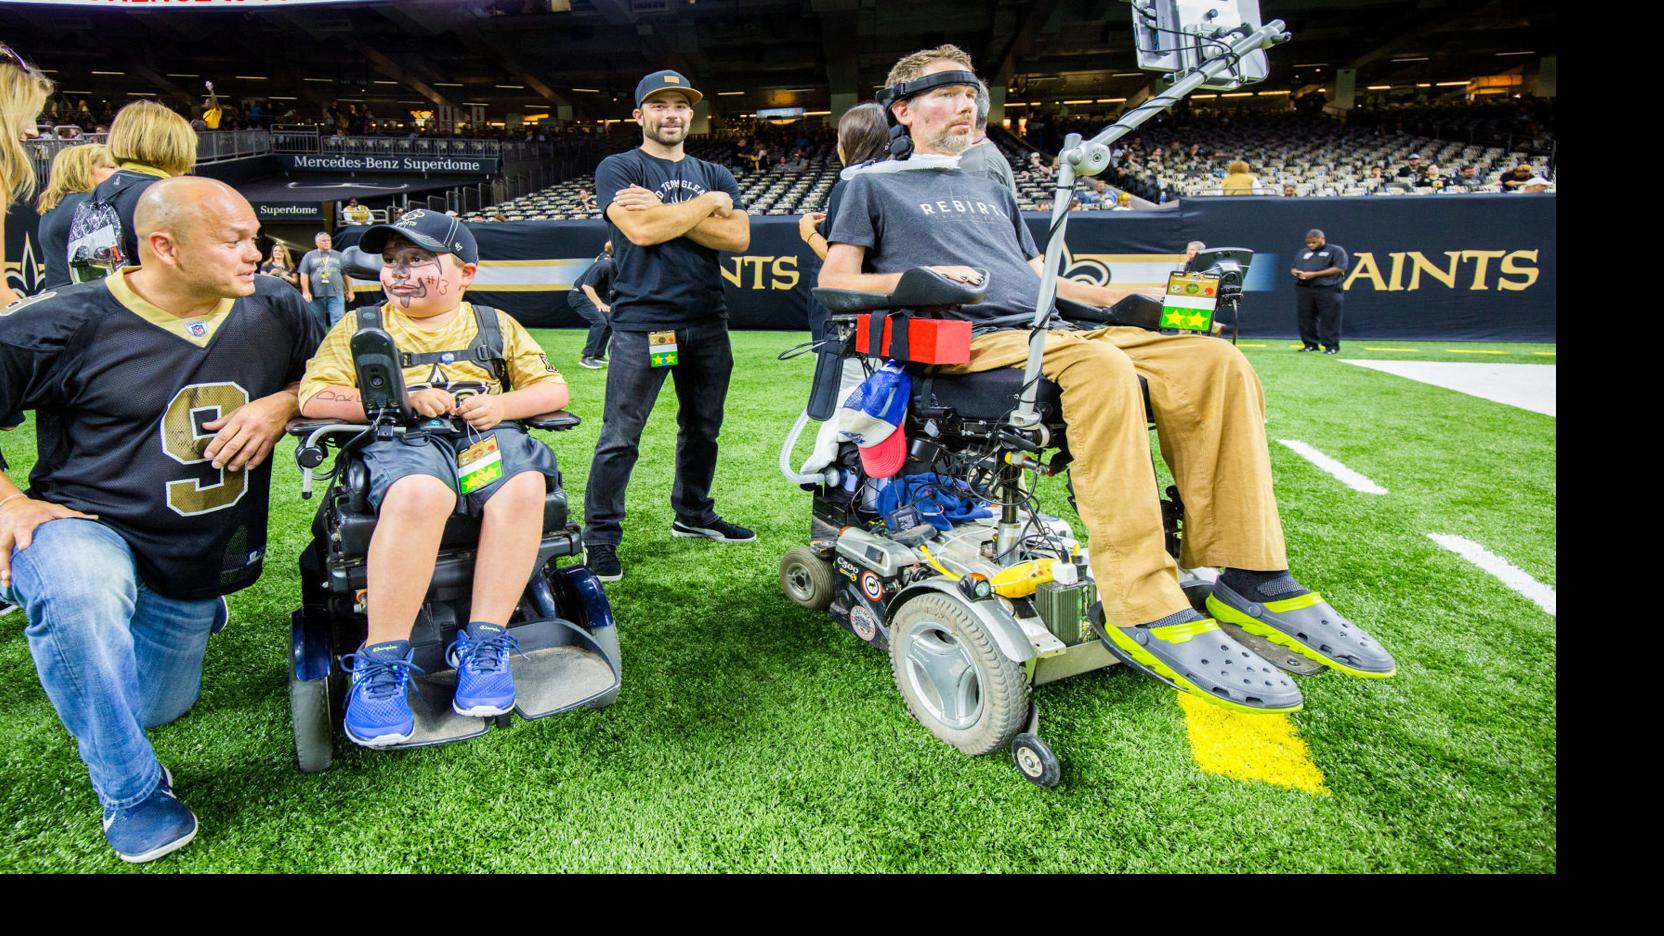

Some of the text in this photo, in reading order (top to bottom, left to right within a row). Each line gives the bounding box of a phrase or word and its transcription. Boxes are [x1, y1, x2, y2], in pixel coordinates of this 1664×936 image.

[294, 156, 480, 171] Mercedes-Benz Superdome
[661, 179, 680, 192] TEAM
[681, 180, 706, 195] GLEA
[260, 205, 318, 216] Superdome
[720, 255, 800, 290] NTS
[1343, 249, 1540, 291] AINTS
[160, 381, 250, 518] 9
[837, 556, 859, 574] C500
